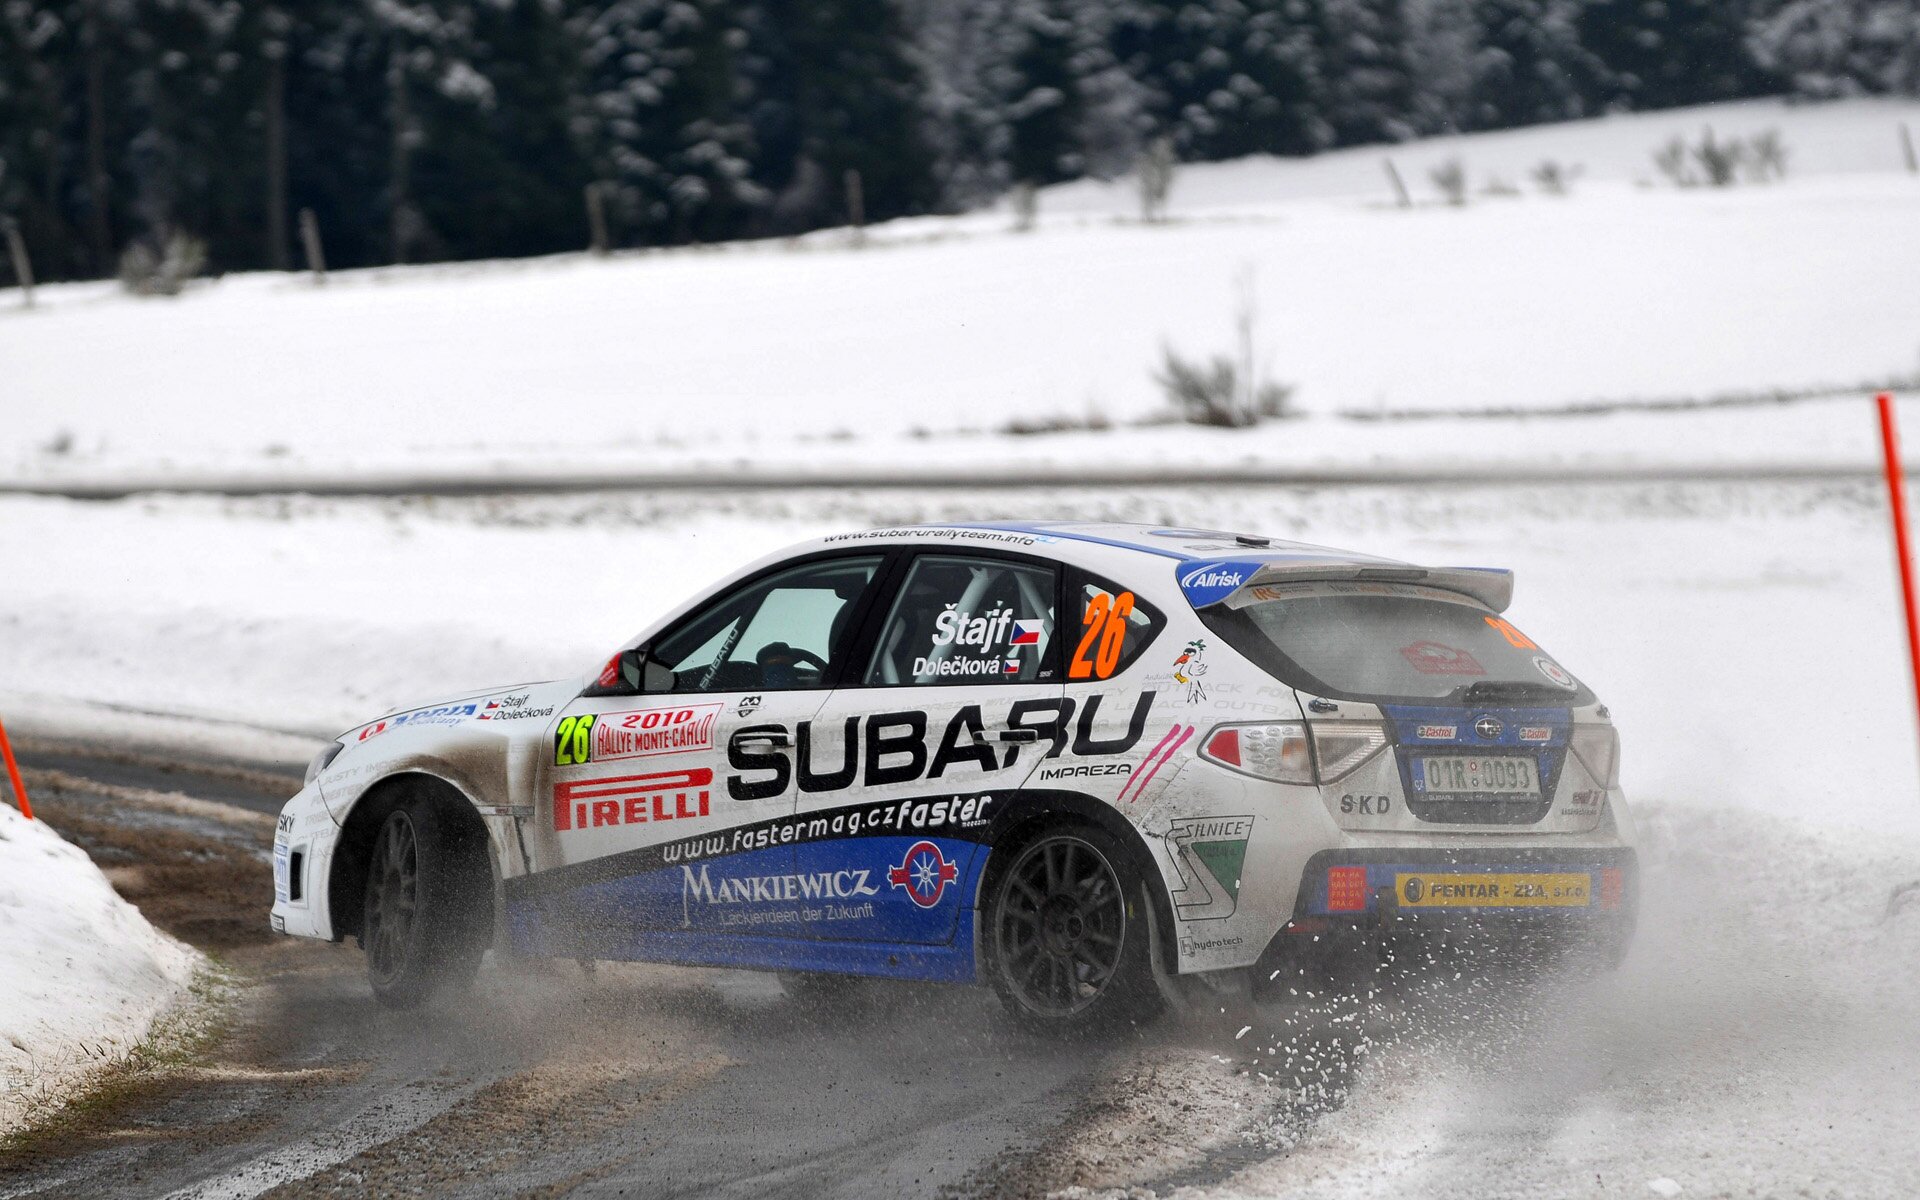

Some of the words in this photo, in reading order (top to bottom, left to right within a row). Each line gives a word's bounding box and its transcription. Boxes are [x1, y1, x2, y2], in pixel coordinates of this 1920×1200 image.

[824, 529, 1034, 546] www.subarurallyteam.info
[1193, 570, 1242, 588] Allrisk
[931, 601, 1014, 654] Štajf
[1068, 592, 1134, 680] 26
[699, 628, 738, 691] SUBARU
[912, 655, 1000, 677] Dolečková
[501, 694, 529, 708] Štajf
[493, 704, 555, 720] Dolečková
[622, 710, 694, 729] 2010
[556, 714, 594, 764] 26
[598, 722, 632, 756] RALLYE
[1425, 727, 1453, 738] Castrol
[1526, 729, 1549, 740] Castrol
[727, 691, 1156, 800] SUBARU
[1040, 764, 1131, 781] IMPREZA
[1414, 779, 1425, 790] CZ
[554, 768, 713, 831] PIRELLI
[1340, 794, 1391, 815] SKD
[896, 795, 992, 829] faster
[663, 806, 896, 863] www.fastermag.cz
[1432, 884, 1499, 898] PENTAR
[1552, 886, 1587, 897] s.r.o.
[802, 907, 822, 921] der
[825, 902, 874, 920] Zukunft
[1194, 936, 1244, 950] hydrotech
